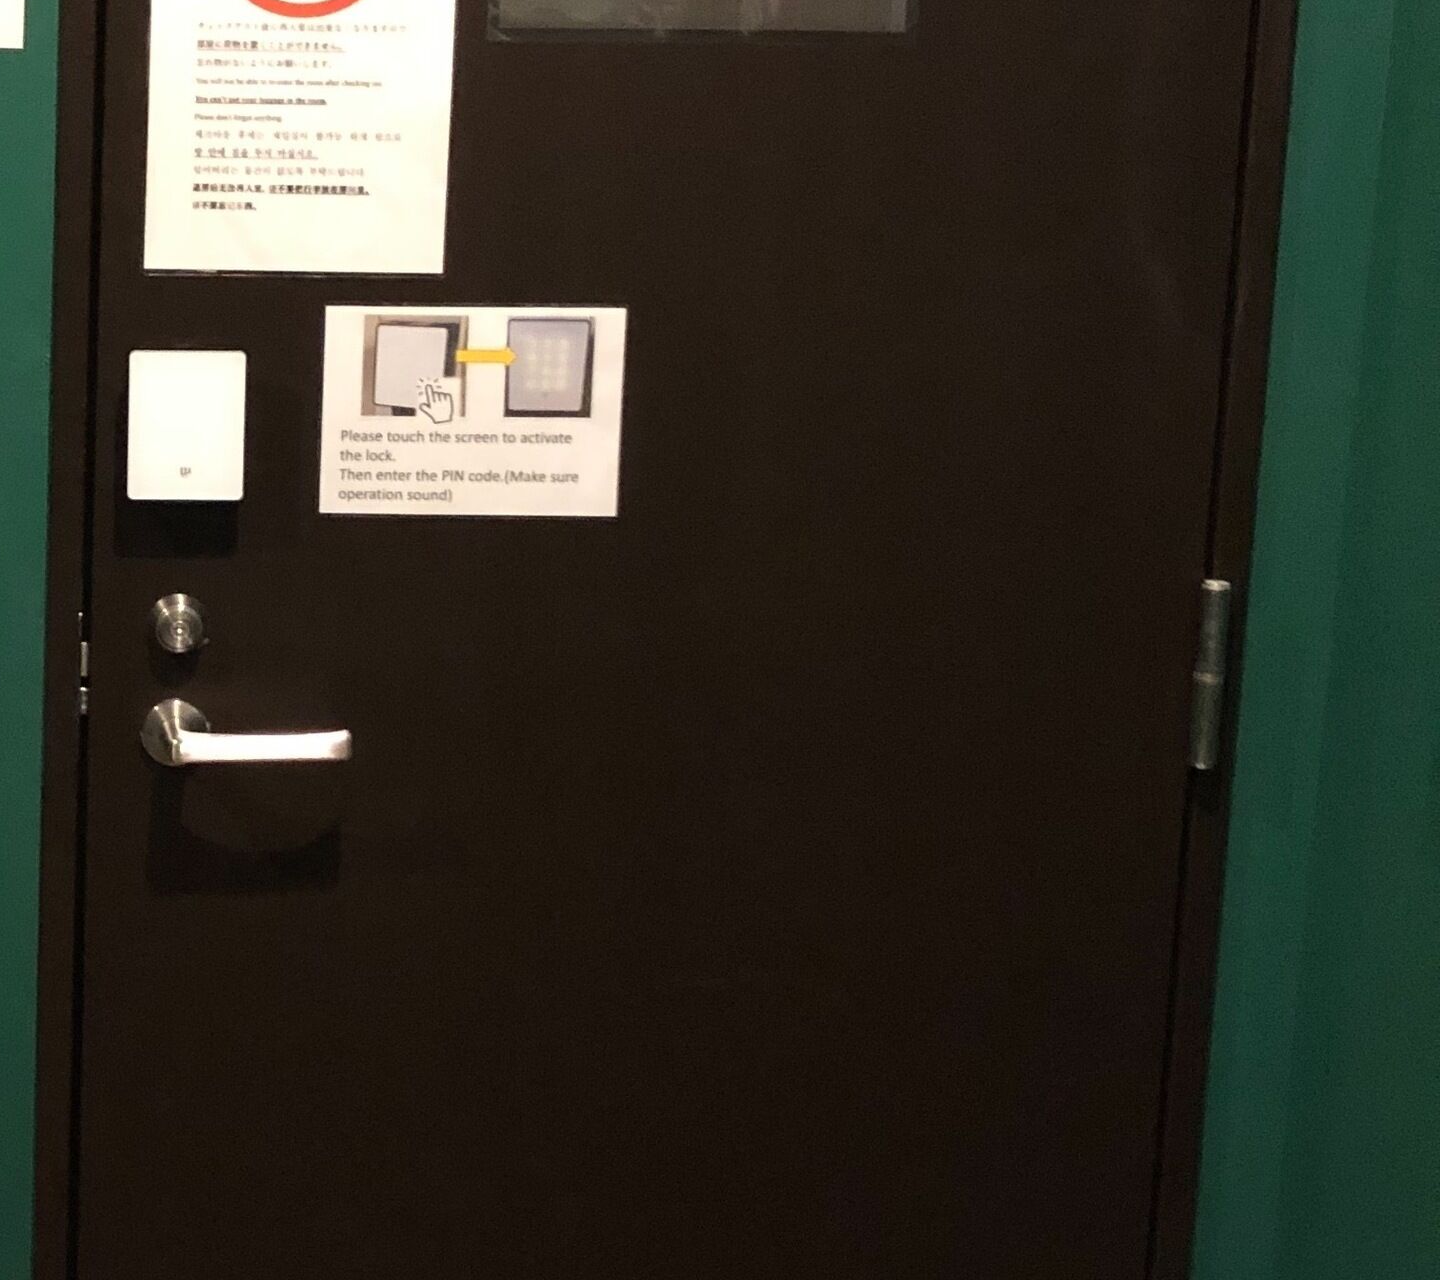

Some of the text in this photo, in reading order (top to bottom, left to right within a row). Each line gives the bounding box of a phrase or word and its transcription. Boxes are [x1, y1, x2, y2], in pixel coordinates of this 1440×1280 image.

[340, 429, 573, 444] Please touch the screen to activate
[339, 448, 396, 462] the lock.
[339, 468, 372, 481] Then
[375, 470, 412, 482] enter
[415, 469, 438, 482] the
[441, 469, 465, 482] PIN
[550, 472, 580, 483] sure
[337, 488, 453, 503] operation sound)
